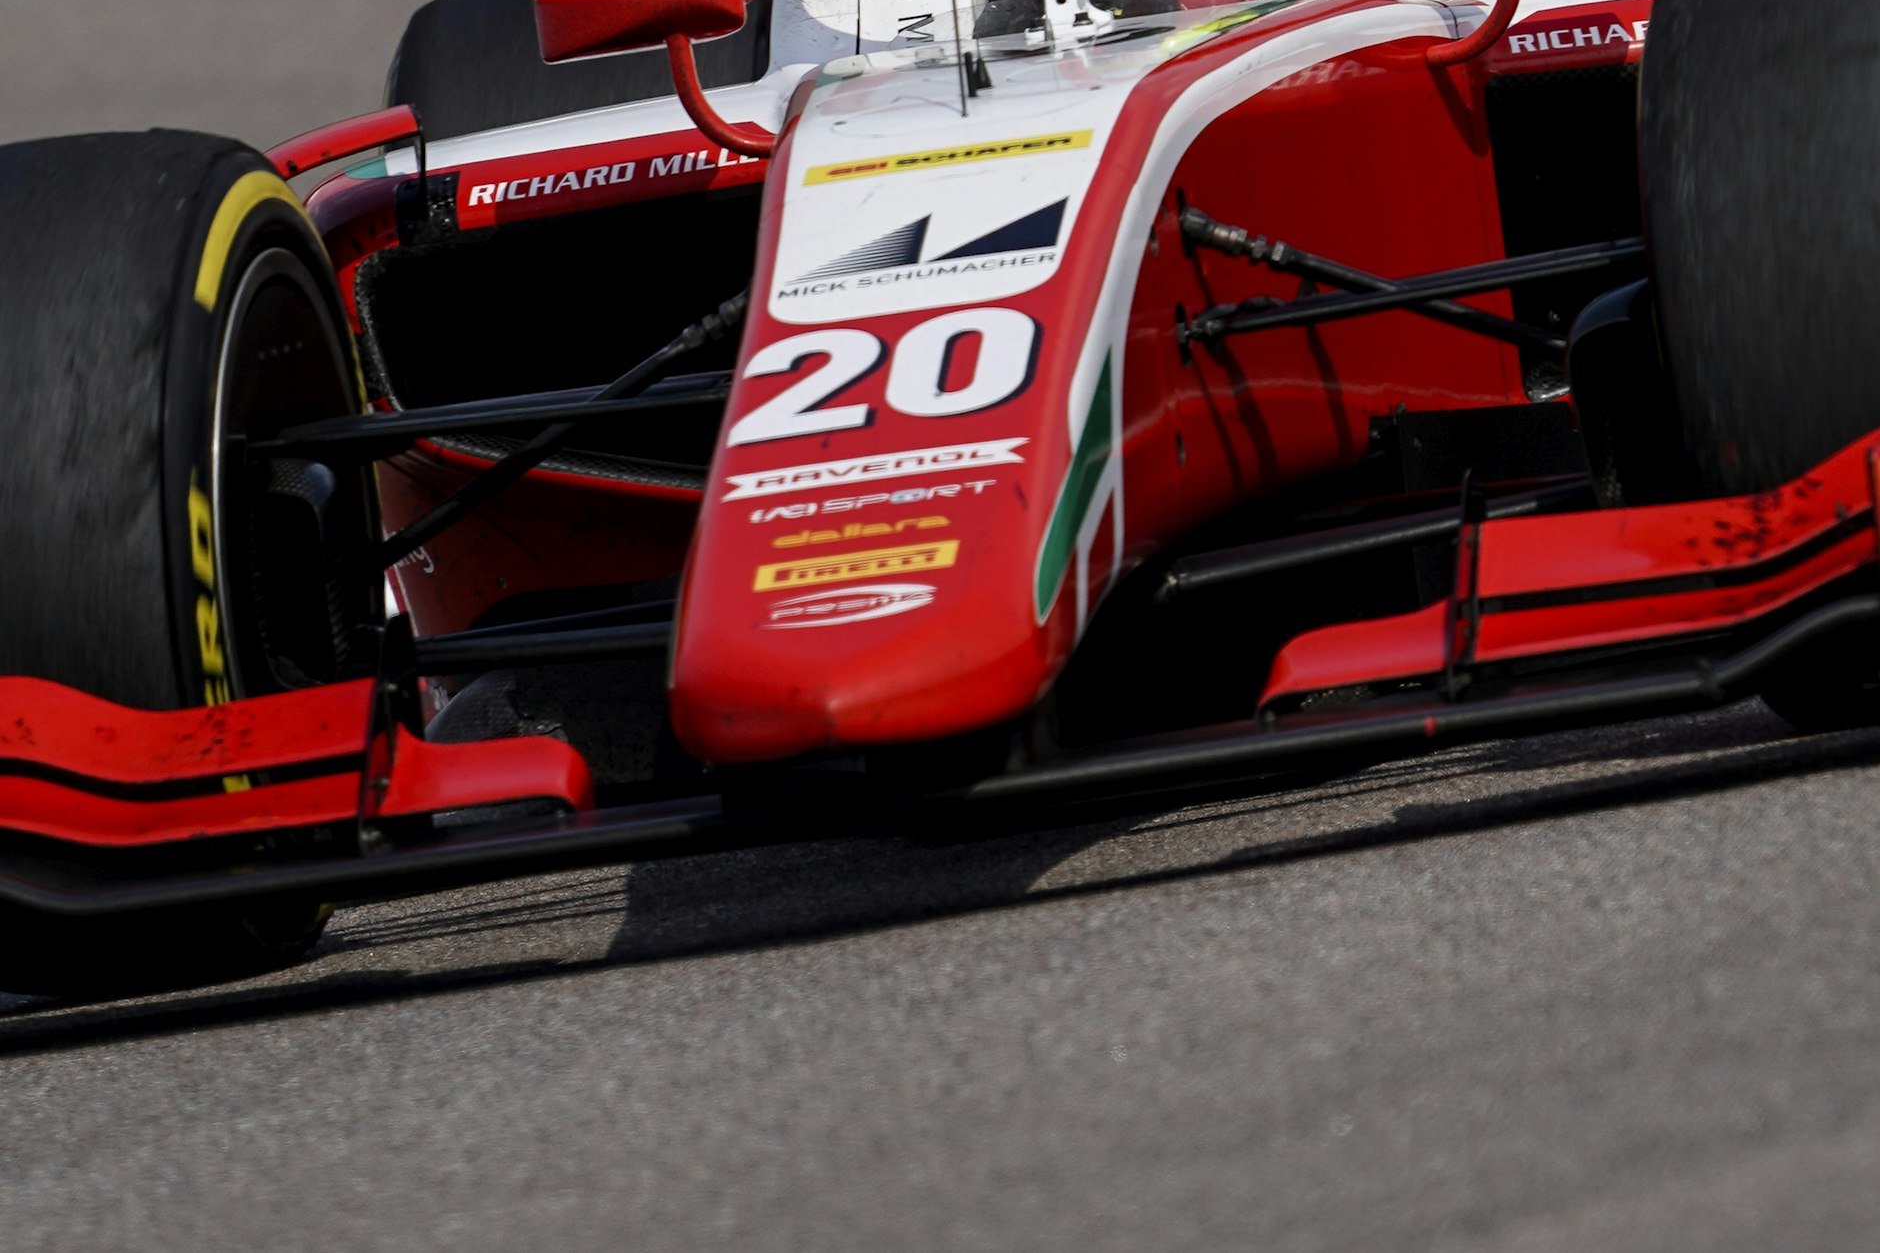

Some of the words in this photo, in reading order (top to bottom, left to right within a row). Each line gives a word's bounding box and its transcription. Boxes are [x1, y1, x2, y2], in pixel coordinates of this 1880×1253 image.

[468, 161, 636, 206] RICHARD
[777, 281, 847, 299] MICK
[857, 252, 1057, 289] SCHUMACHER
[727, 307, 1043, 447] 20
[755, 449, 997, 488] RAVENOL
[821, 479, 997, 514] SPORT
[772, 516, 949, 548] dallara
[773, 547, 941, 583] PIRELLI
